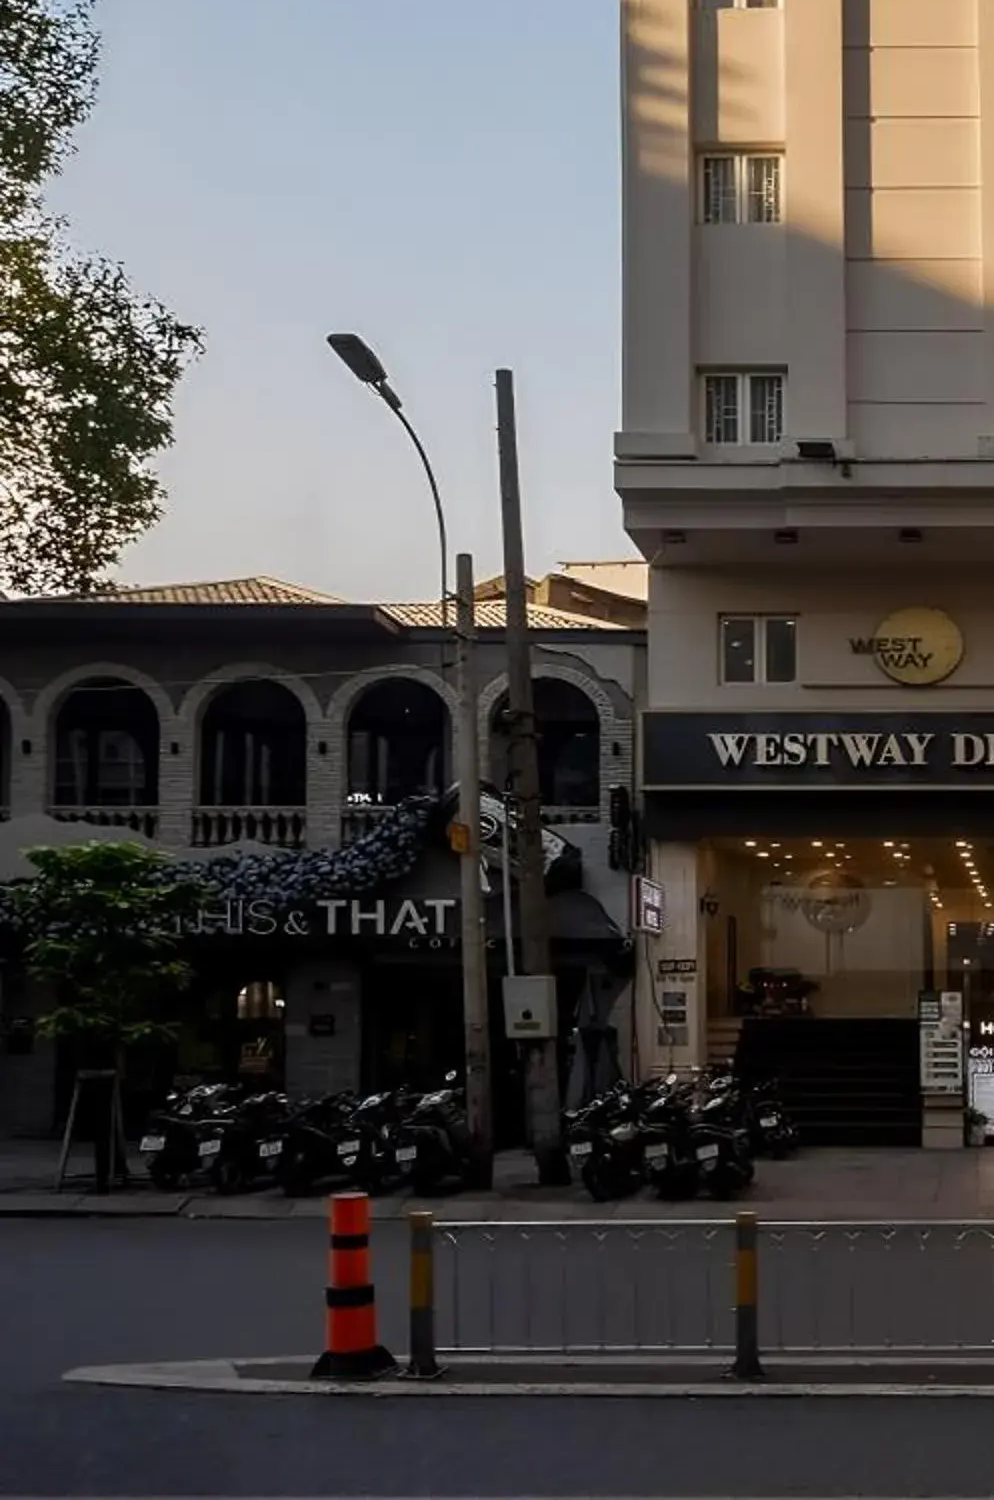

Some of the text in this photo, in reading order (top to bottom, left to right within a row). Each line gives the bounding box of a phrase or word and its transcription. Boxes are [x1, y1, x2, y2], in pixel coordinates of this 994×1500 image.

[849, 638, 922, 655] WEST
[880, 653, 933, 668] WAY
[708, 733, 935, 768] WESTWAY
[174, 899, 458, 936] HIS & THAT
